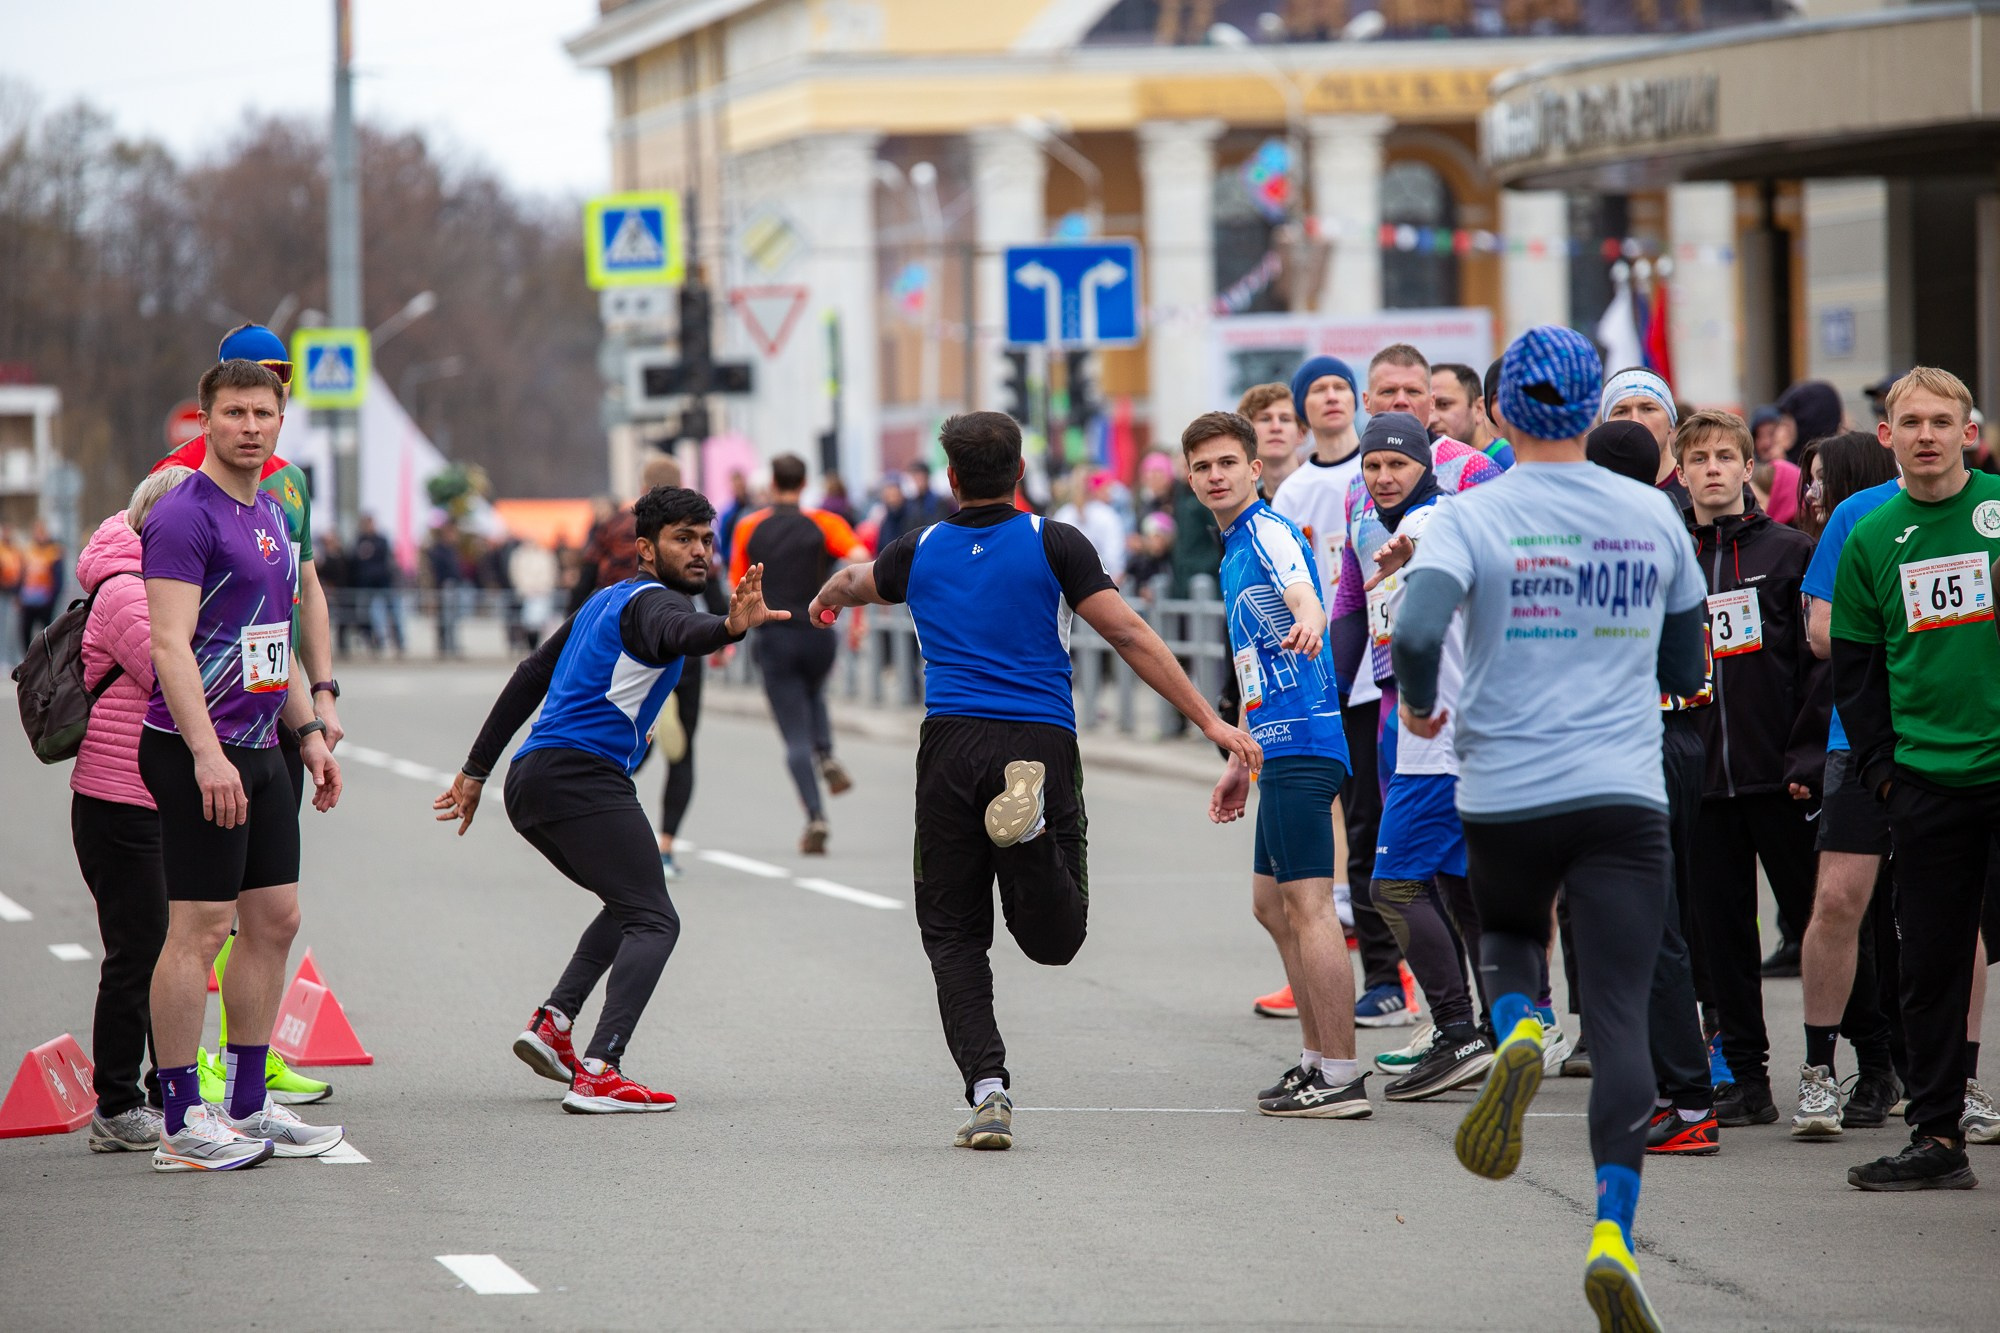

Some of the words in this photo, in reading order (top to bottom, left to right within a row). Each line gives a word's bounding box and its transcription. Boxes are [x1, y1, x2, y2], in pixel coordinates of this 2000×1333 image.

[1386, 436, 1404, 446] RW
[1511, 577, 1575, 597] БЕГАТЬ
[1577, 560, 1658, 618] МОДНО
[1931, 574, 1964, 611] 65
[1511, 604, 1562, 619] любить
[267, 642, 284, 675] 97
[1454, 1038, 1486, 1061] HOKA
